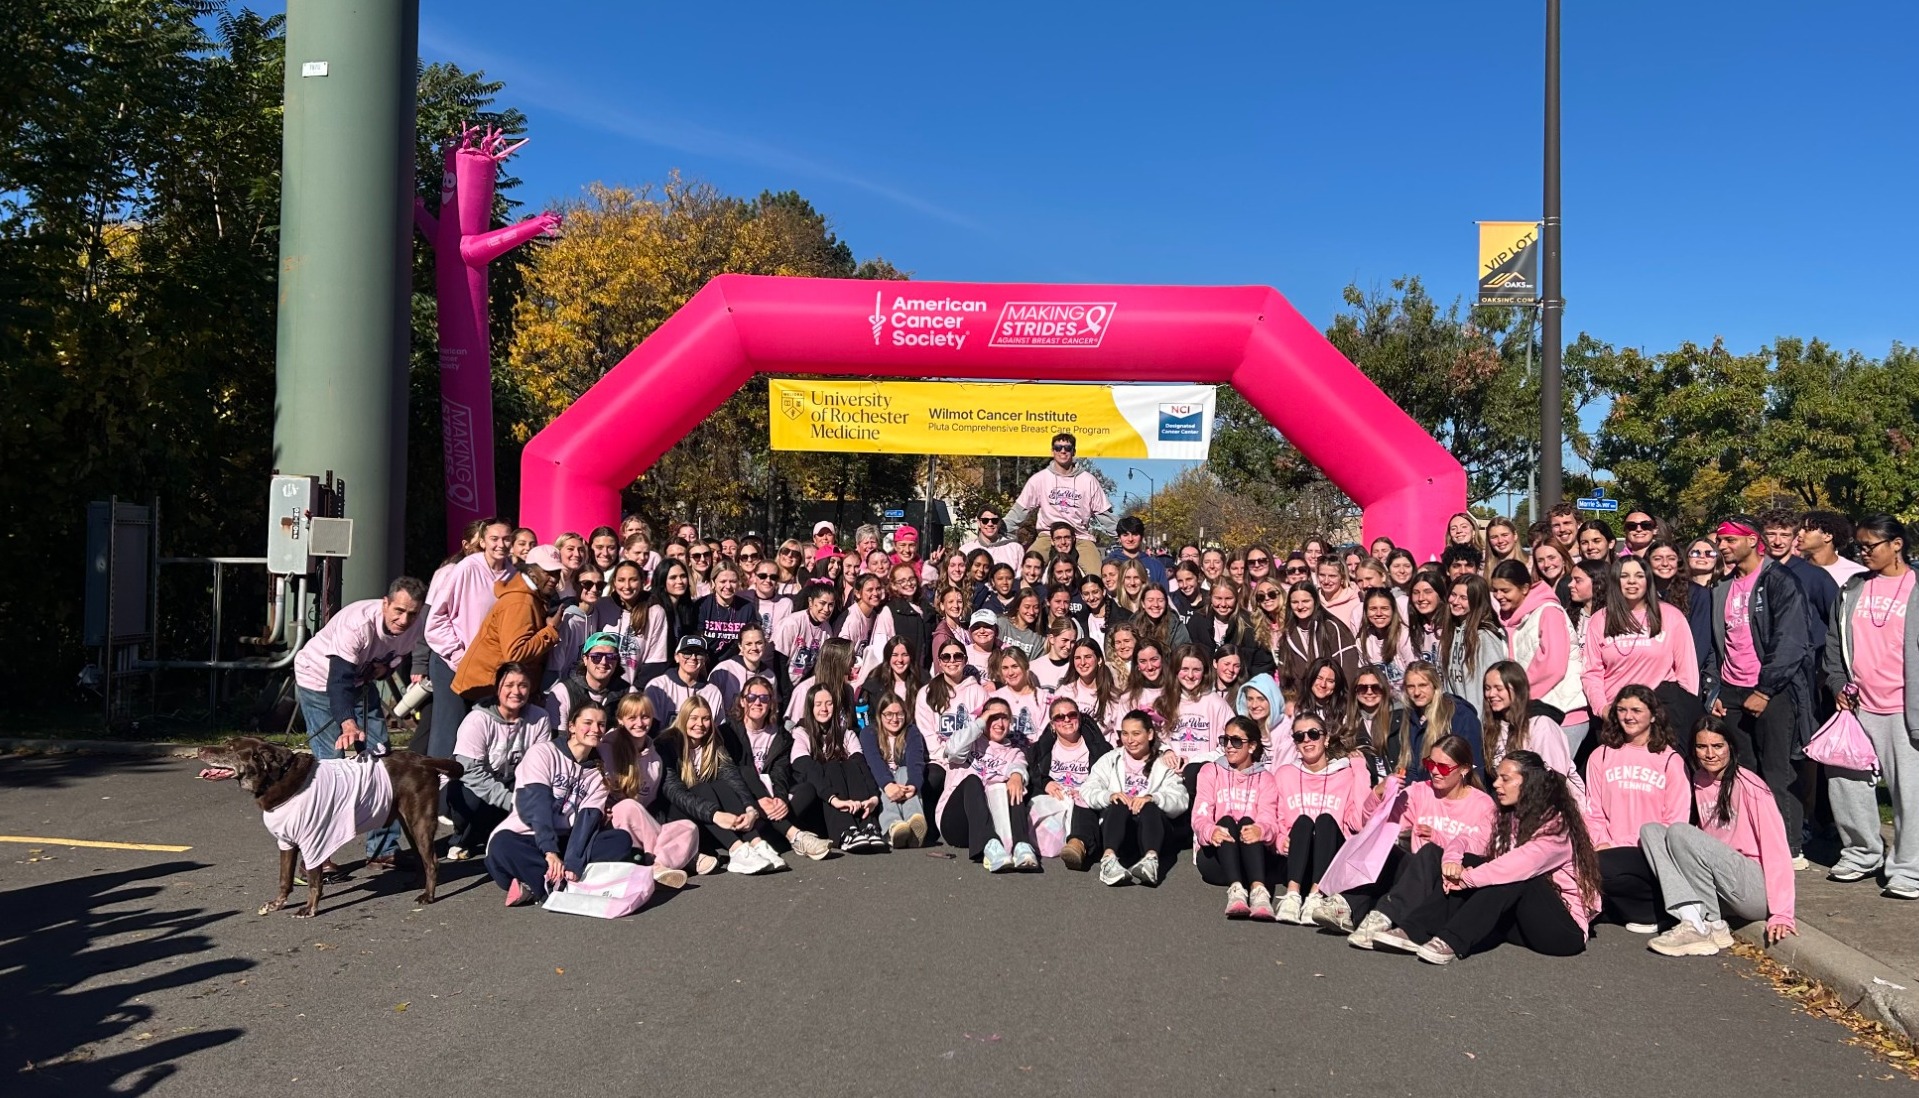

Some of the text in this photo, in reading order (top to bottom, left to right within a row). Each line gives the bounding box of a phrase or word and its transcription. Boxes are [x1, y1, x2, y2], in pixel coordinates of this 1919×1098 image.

[1484, 232, 1533, 271] VIP LOT
[1504, 281, 1526, 289] OAKS
[892, 296, 987, 312] American
[891, 312, 964, 329] Cancer
[1007, 306, 1085, 321] MAKING
[1002, 321, 1078, 336] STRIDES
[1031, 337, 1060, 345] BREAST
[811, 391, 893, 410] University
[811, 408, 909, 424] of Rochester
[929, 408, 1077, 422] Wilmot Cancer Institute
[1171, 406, 1190, 414] NCI
[811, 424, 880, 440] Medicine
[928, 423, 1110, 436] Pluta Comprehensive Breast Care Program
[451, 409, 472, 483] MAKING
[1856, 596, 1908, 618] ENESEO
[1189, 717, 1210, 728] Wave
[1051, 760, 1069, 773] Blue
[1605, 765, 1666, 790] GENESEO
[1618, 780, 1652, 793] TENNIS
[1217, 787, 1256, 804] GENESE
[1287, 793, 1341, 810] GENESEO
